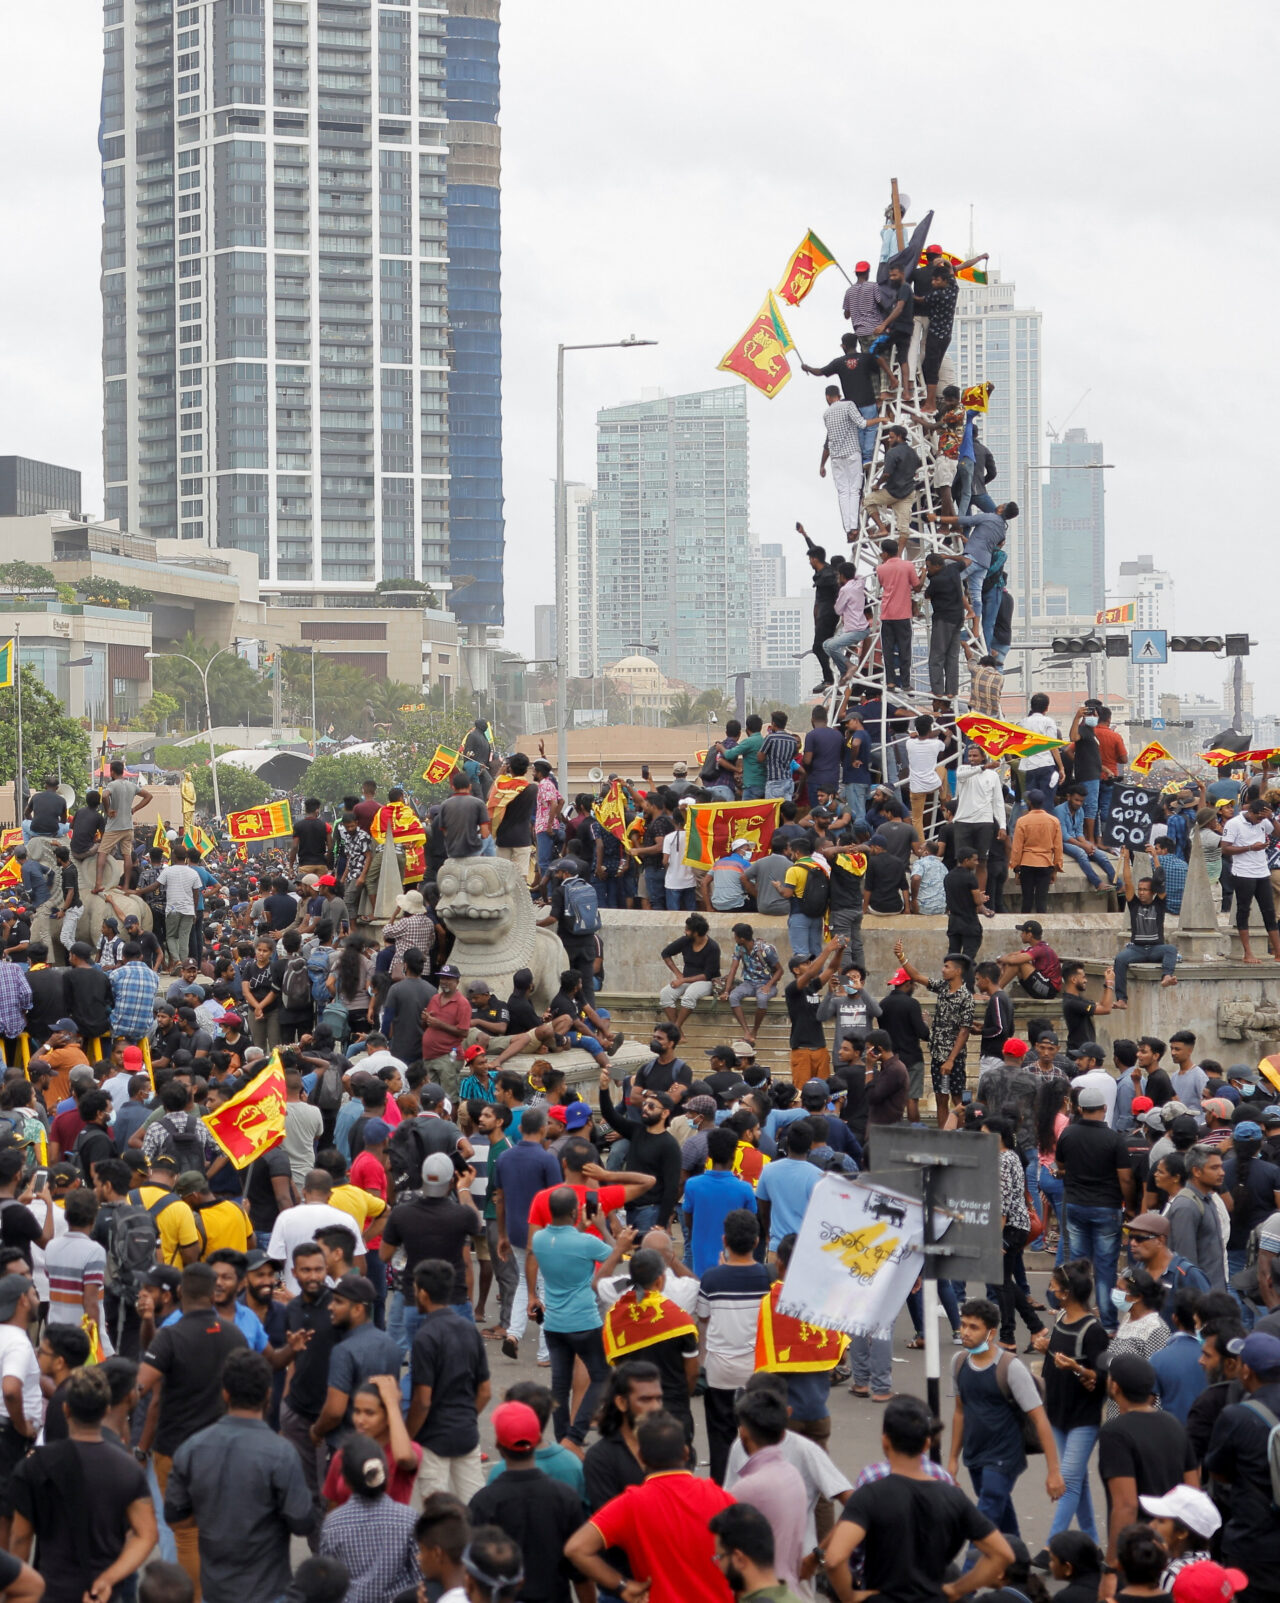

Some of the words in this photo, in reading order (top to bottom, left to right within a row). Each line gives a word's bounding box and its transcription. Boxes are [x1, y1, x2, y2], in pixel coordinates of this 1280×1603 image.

[1120, 790, 1149, 806] GO
[1112, 807, 1152, 825] GOTA
[1112, 825, 1145, 844] GO
[948, 1198, 959, 1210] By
[960, 1199, 981, 1210] Order
[982, 1201, 991, 1210] of
